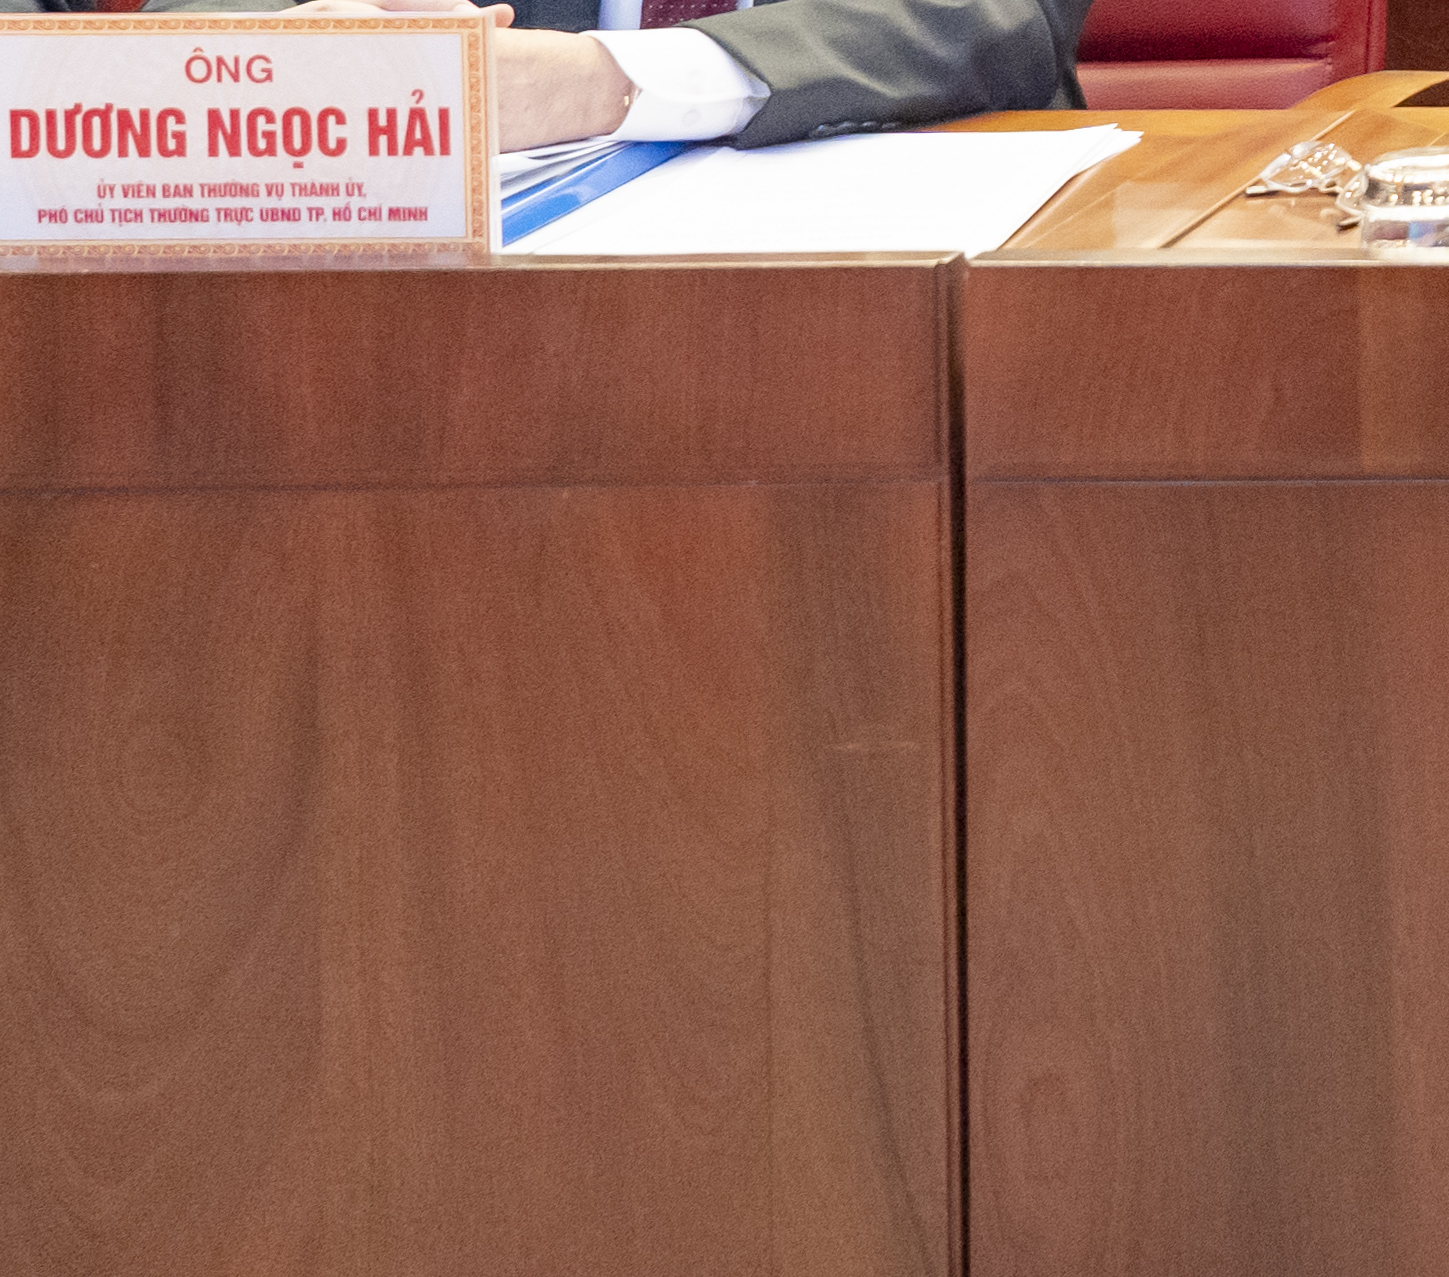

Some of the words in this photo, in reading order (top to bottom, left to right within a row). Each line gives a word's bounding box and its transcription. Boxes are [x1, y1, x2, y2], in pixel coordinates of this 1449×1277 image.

[184, 47, 273, 84] ÔNG
[9, 102, 187, 160] DƯƠNG
[206, 106, 348, 169] NGỌC
[367, 88, 451, 157] HẢI
[96, 179, 115, 199] ỦY
[121, 180, 156, 199] VIÊN
[161, 183, 194, 198] BAN
[199, 181, 260, 199] THƯỜNG
[265, 183, 285, 201] VỤ
[290, 179, 340, 198] THÀNH
[37, 205, 68, 224] PHÓ
[74, 204, 104, 224] CHỦ
[110, 208, 144, 227] TỊCH
[215, 207, 253, 227] TRỰC
[259, 207, 301, 223] UBND
[306, 207, 326, 222] TP.
[332, 203, 352, 222] HỒ
[357, 204, 382, 221] CHÍ
[388, 206, 428, 222] MINH
